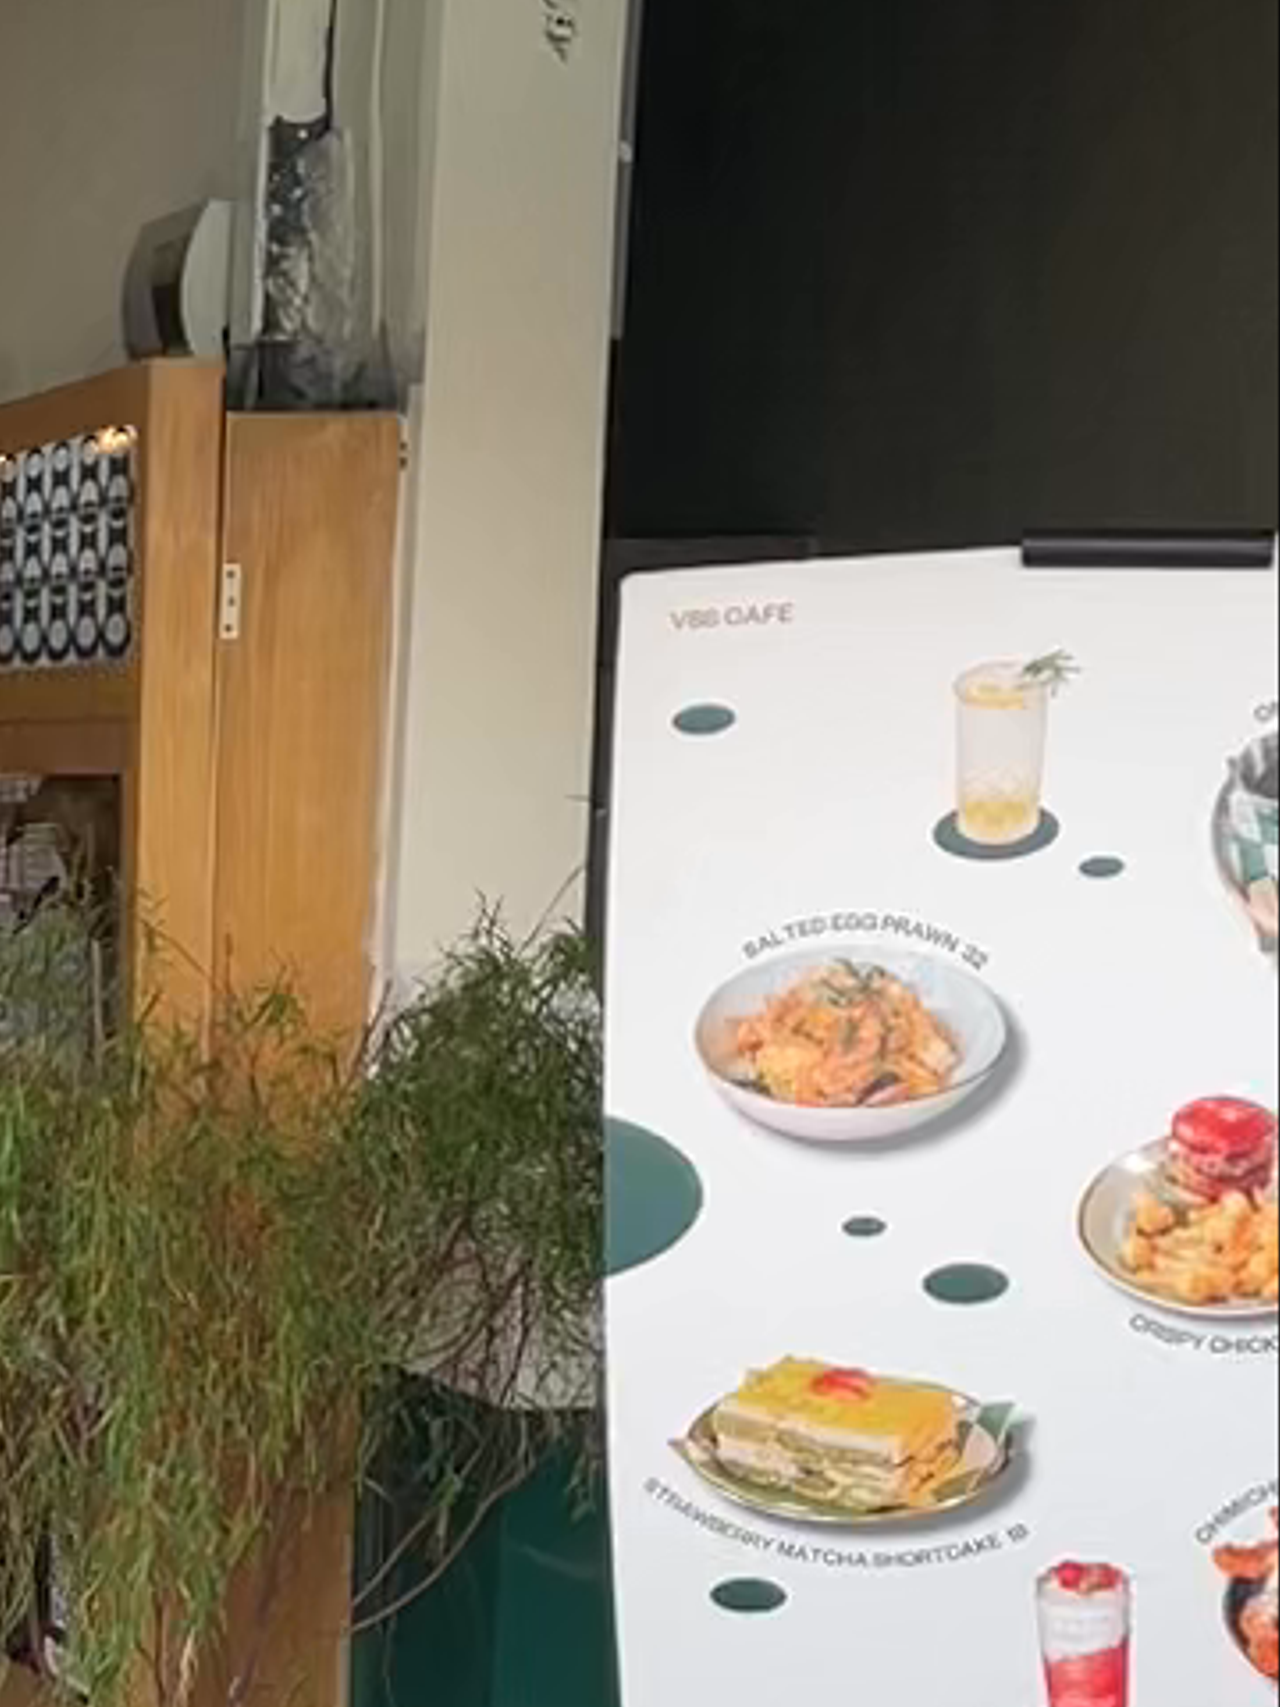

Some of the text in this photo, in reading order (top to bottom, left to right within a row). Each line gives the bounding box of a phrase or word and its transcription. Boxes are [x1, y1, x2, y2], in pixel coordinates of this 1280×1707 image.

[723, 601, 794, 626] CAFE
[742, 915, 827, 960] SALTED
[830, 911, 878, 932] EGG
[879, 913, 960, 953] PRAWN
[1128, 1312, 1208, 1351] CRISPY
[643, 1476, 775, 1551] STRAWBERRY
[776, 1540, 868, 1568] MATCHA
[872, 1530, 1003, 1568] SHORTCAKE
